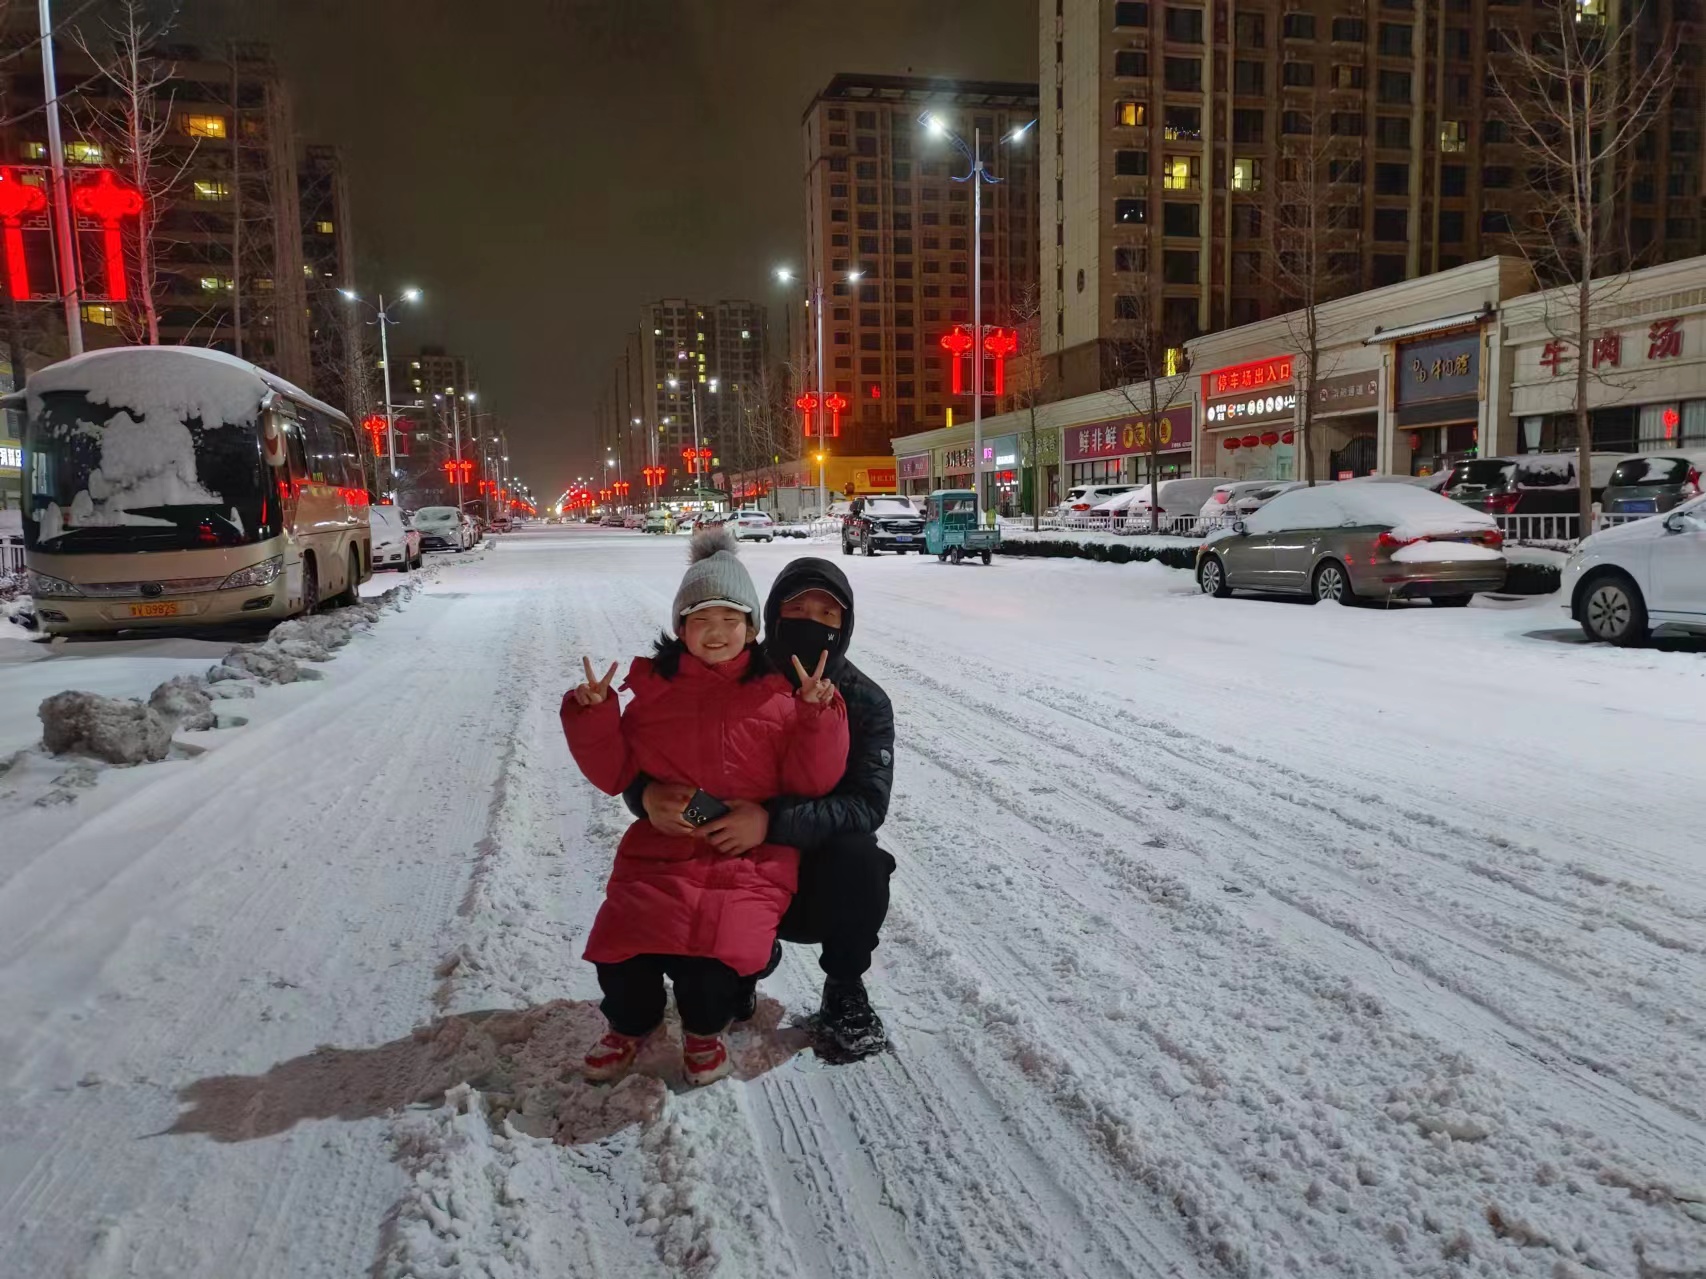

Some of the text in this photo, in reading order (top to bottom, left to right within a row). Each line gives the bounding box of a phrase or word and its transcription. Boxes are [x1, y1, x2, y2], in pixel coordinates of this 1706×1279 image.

[1539, 317, 1685, 376] 牛肉汤
[1218, 363, 1290, 391] 停车场出入口
[1078, 424, 1117, 453] 鲜非鲜
